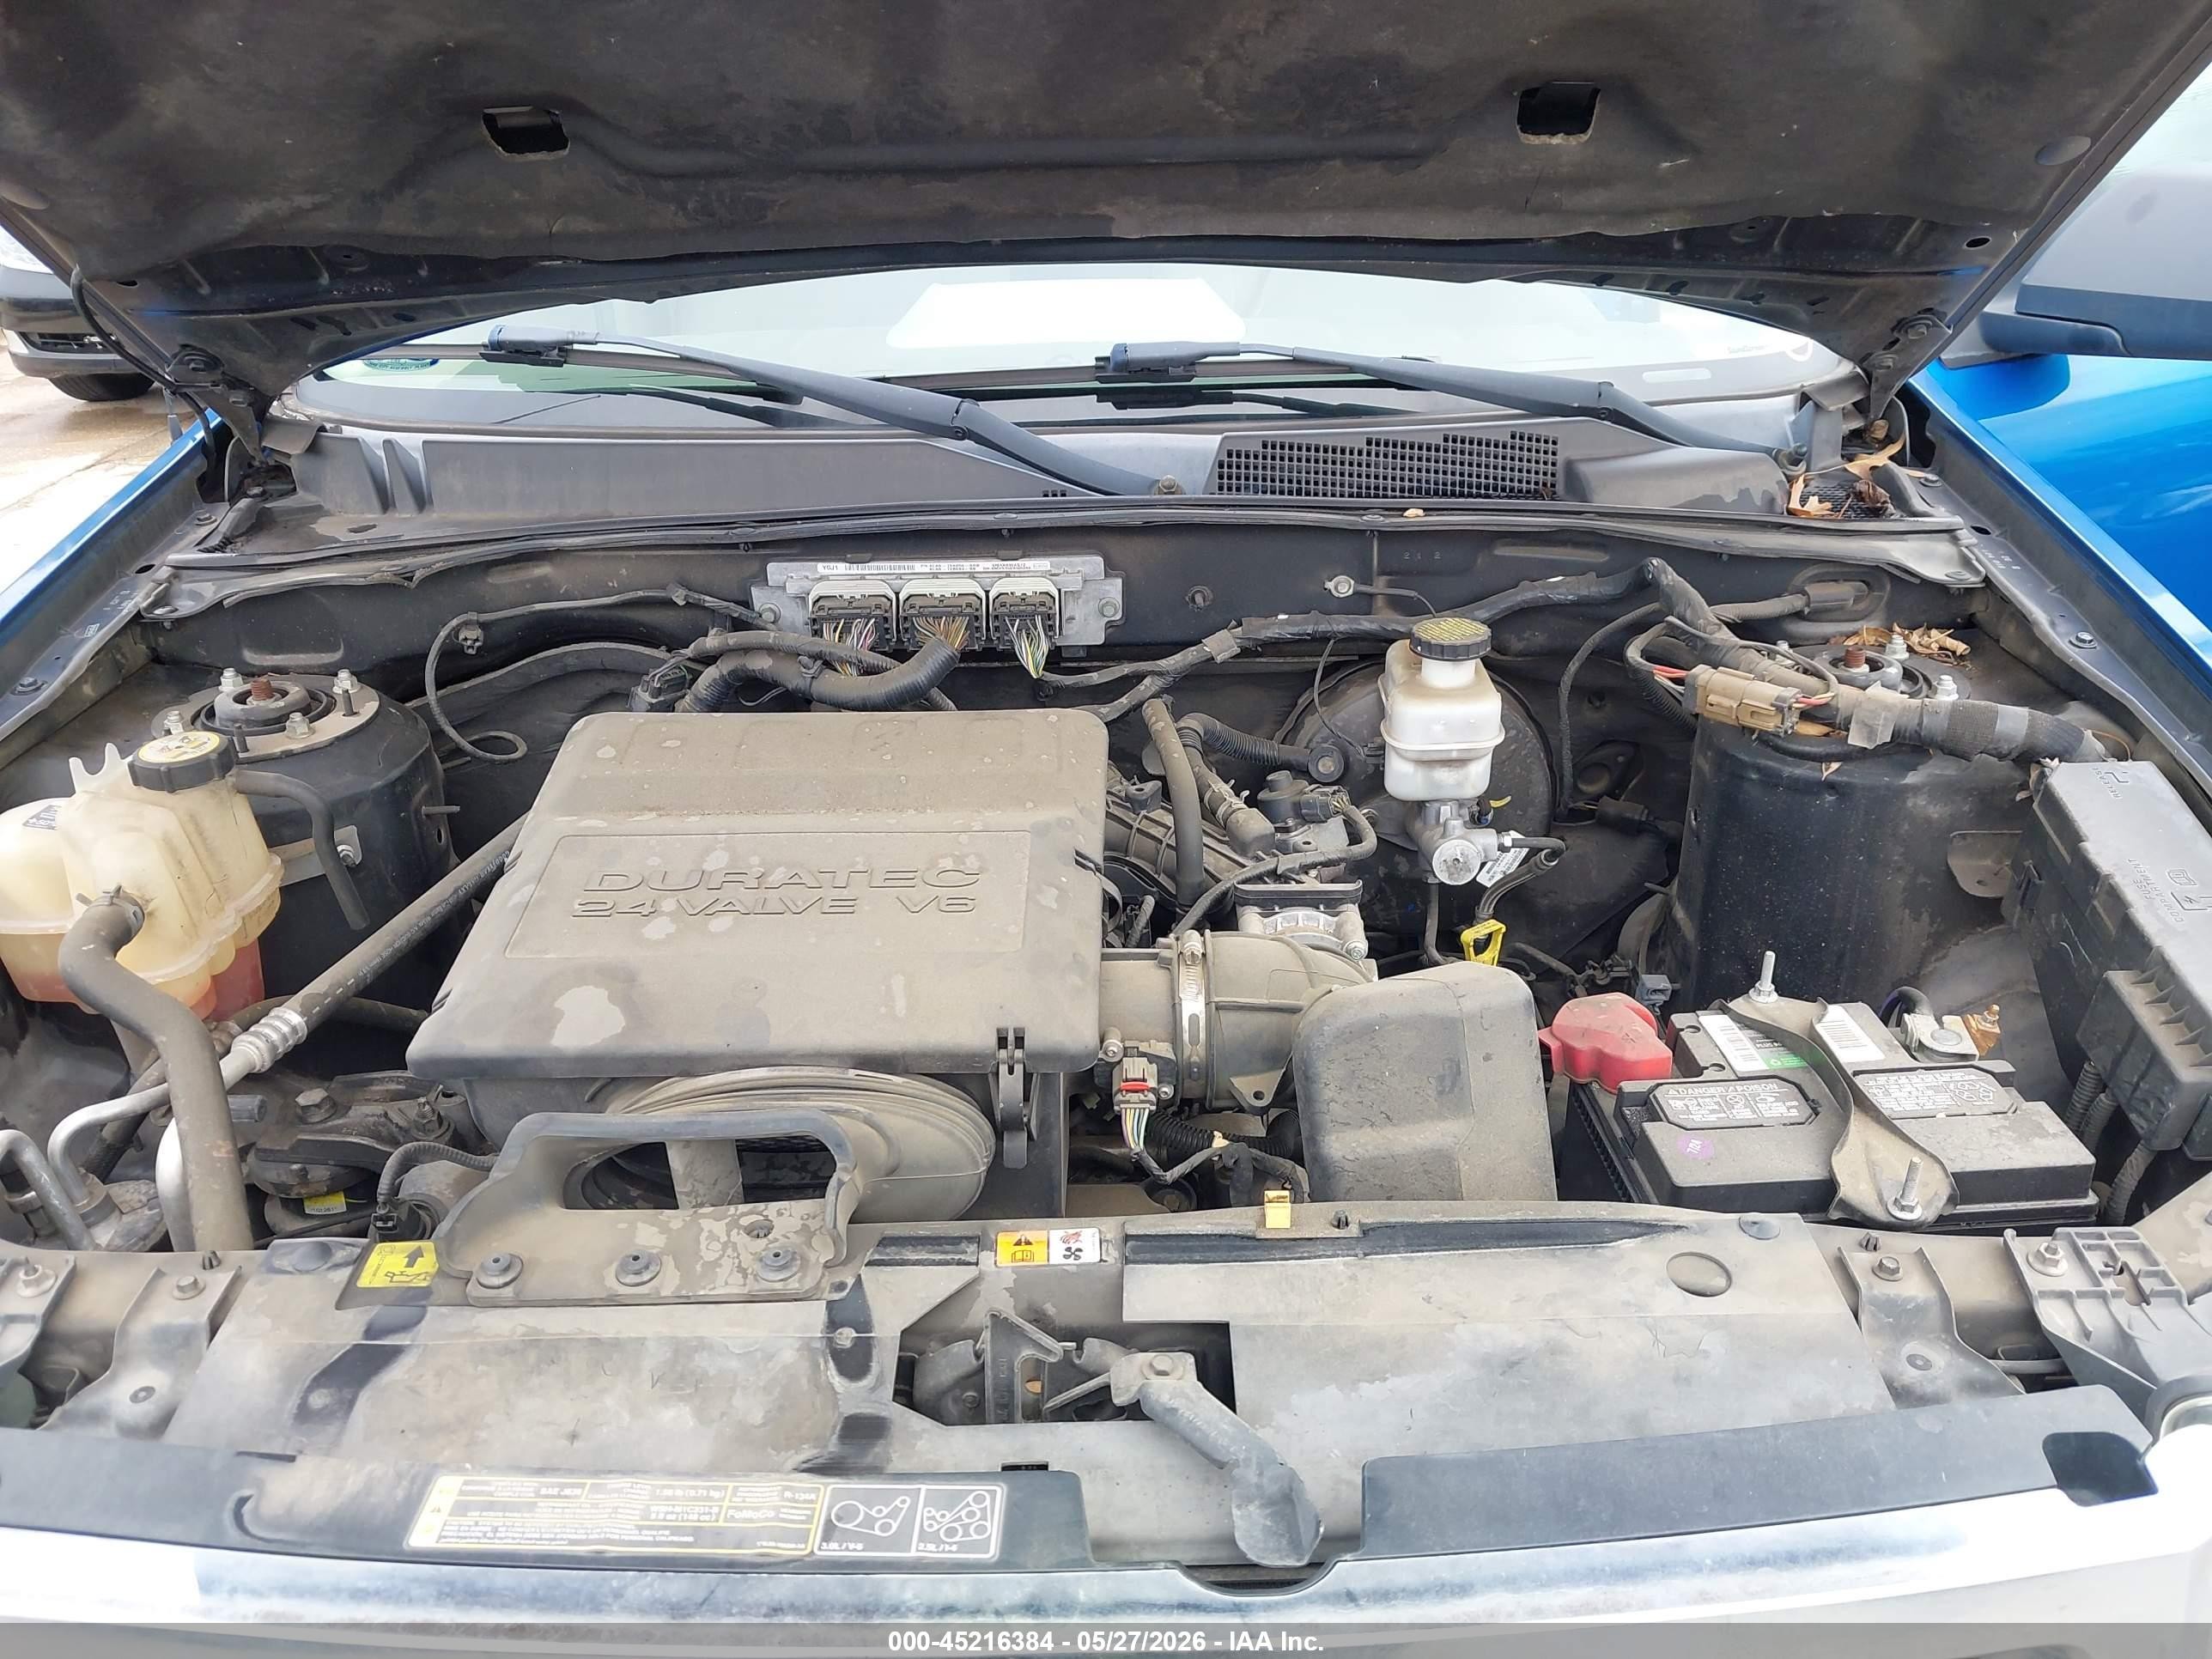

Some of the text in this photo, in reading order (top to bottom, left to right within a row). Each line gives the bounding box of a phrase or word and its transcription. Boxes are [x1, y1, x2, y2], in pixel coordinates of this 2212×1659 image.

[583, 868, 981, 892] DURATEC
[2128, 858, 2185, 923] COMPARTMENT
[2133, 878, 2155, 901] FUSE
[571, 895, 976, 918] 24 VALVE V6
[726, 1509, 775, 1520] FoMoCo
